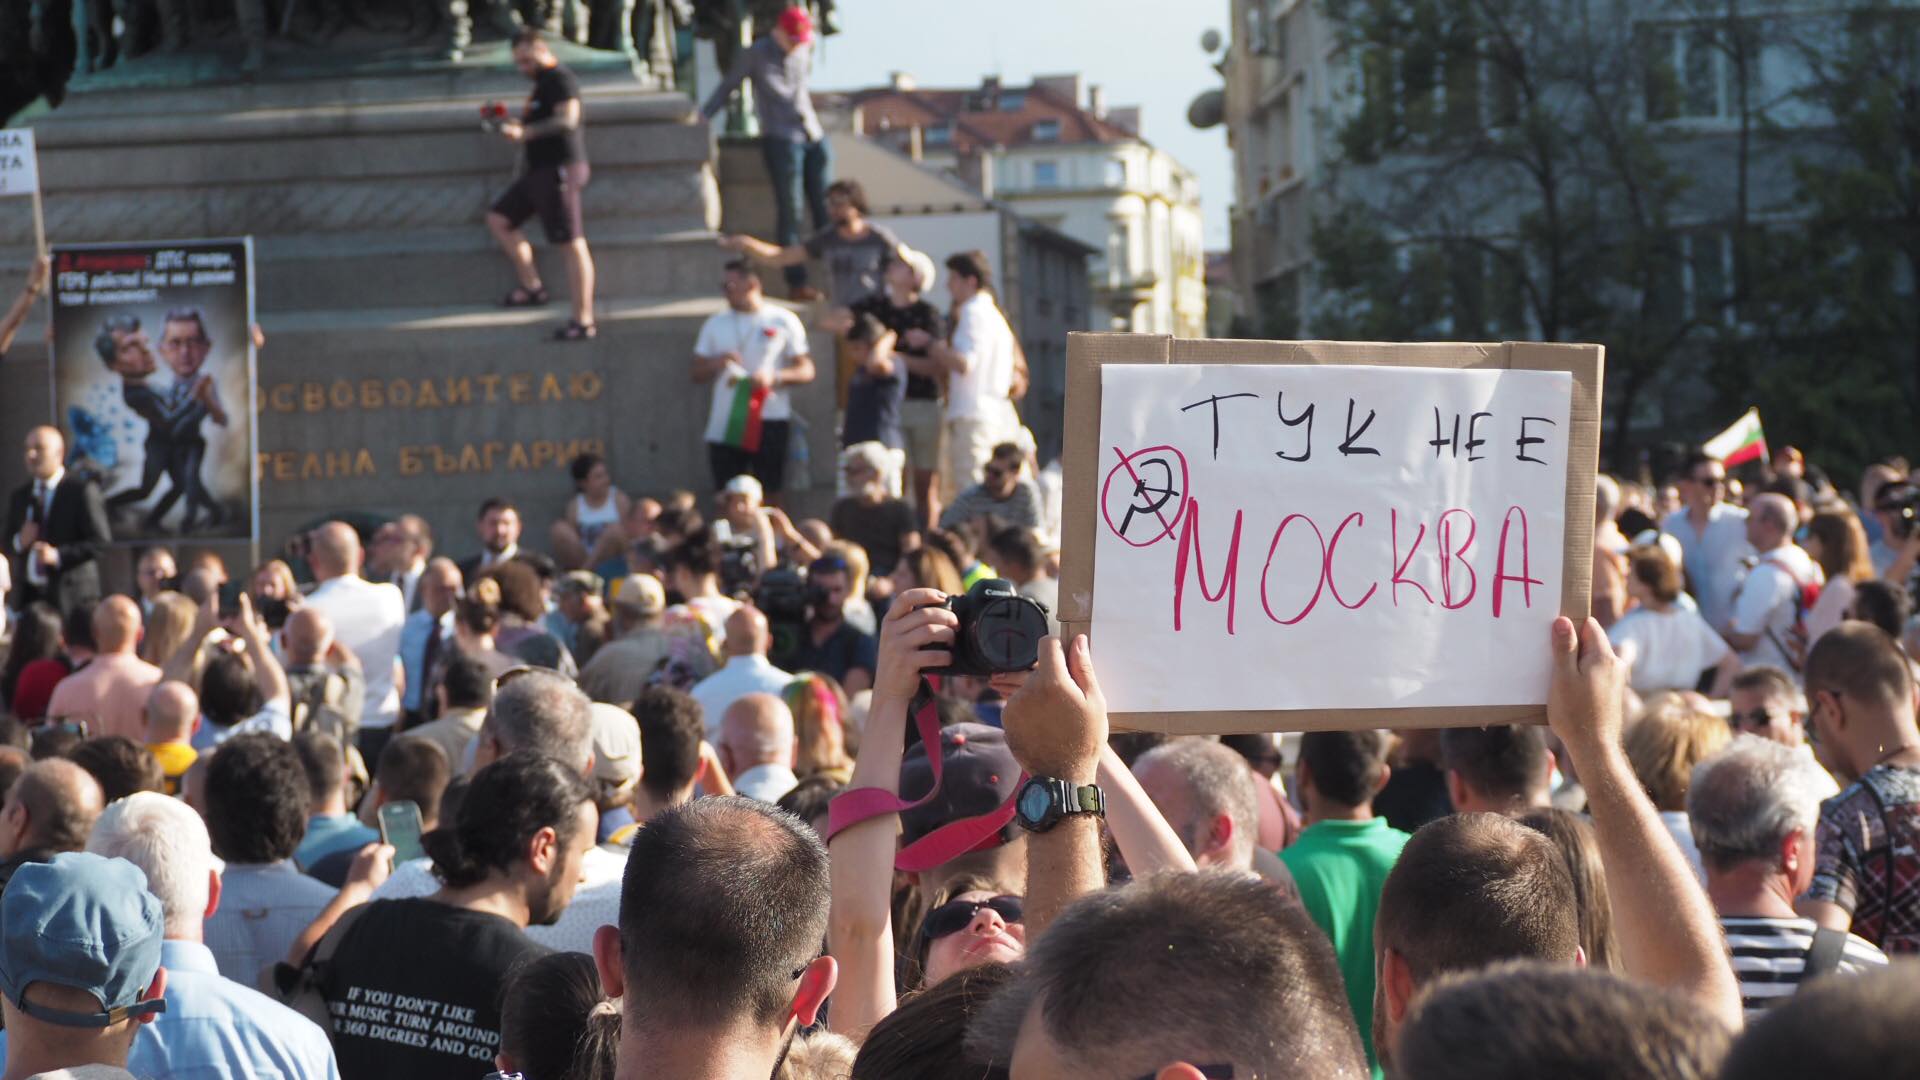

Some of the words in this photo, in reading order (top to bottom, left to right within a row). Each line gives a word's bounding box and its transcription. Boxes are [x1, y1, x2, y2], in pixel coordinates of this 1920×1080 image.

[1181, 391, 1381, 462] ТУК
[1173, 496, 1544, 635] МОСКВА
[984, 588, 1011, 597] Canon
[347, 986, 362, 1001] IF
[364, 989, 393, 1006] YOU
[394, 994, 441, 1015] DON'T
[442, 1004, 476, 1023] LIKE
[349, 1003, 392, 1023] MUSIC
[394, 1011, 432, 1031] TURN
[434, 1020, 500, 1046] AROUND
[343, 1019, 367, 1036] 360
[369, 1023, 430, 1048] DEGREES
[430, 1037, 466, 1056] AND
[467, 1044, 494, 1062] GO.
